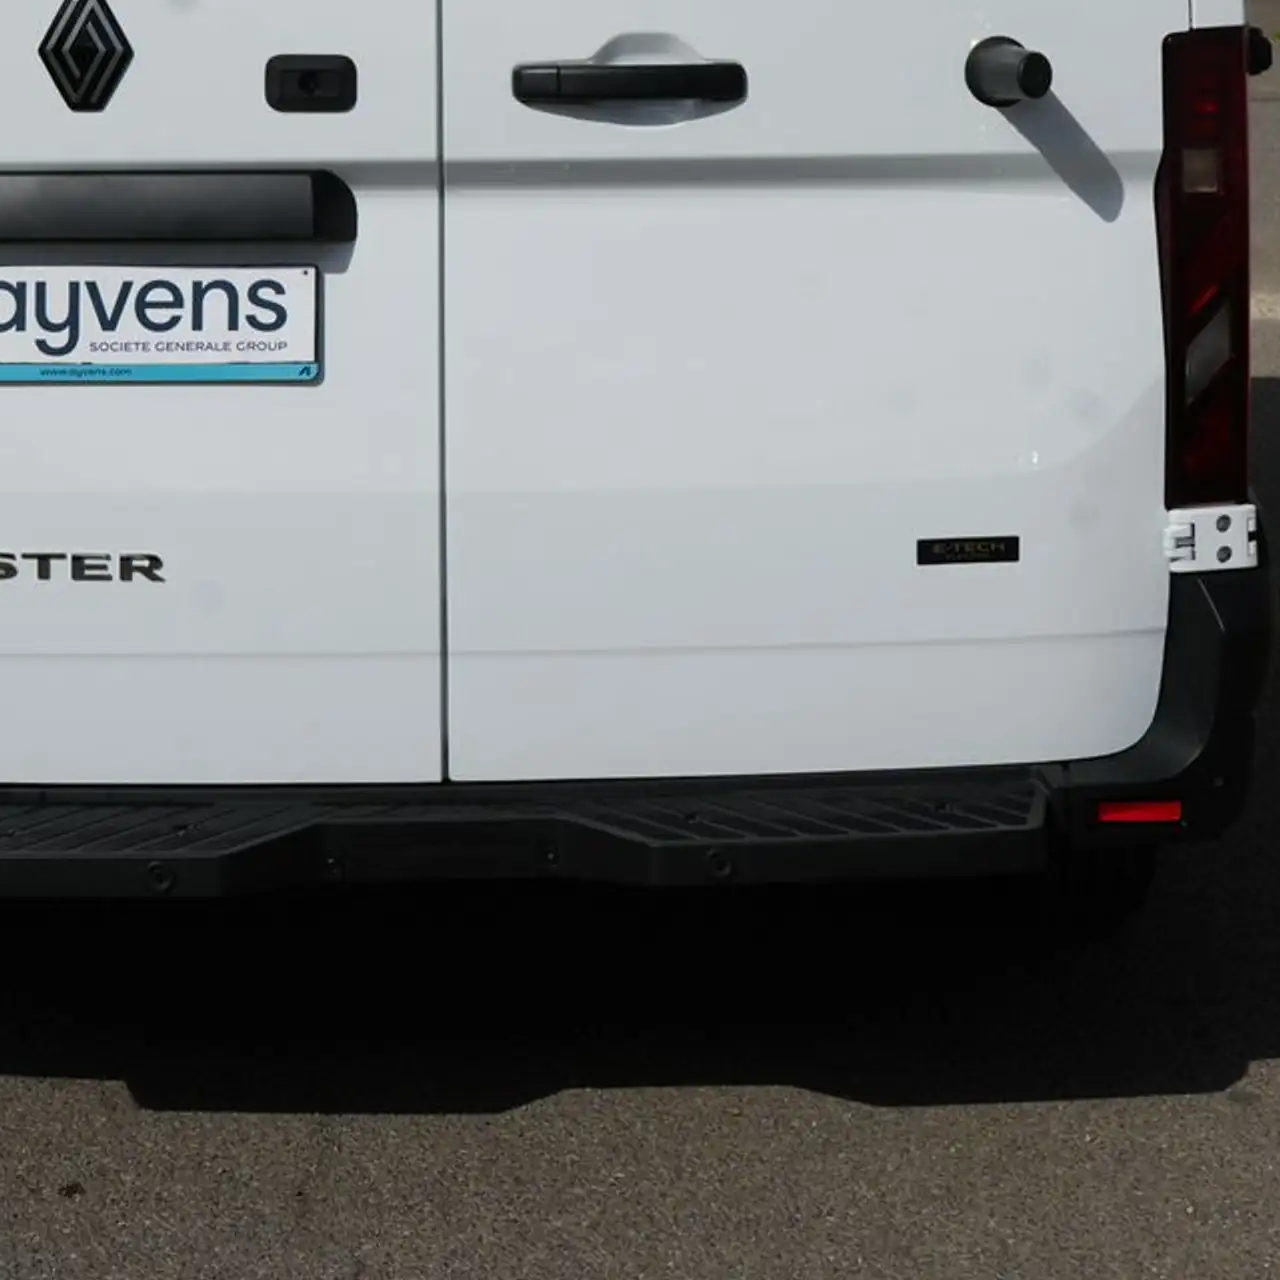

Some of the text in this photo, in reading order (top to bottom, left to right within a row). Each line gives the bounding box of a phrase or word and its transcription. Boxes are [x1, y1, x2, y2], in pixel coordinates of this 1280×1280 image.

[89, 340, 288, 352] SOCIETE GENERALE GROUP
